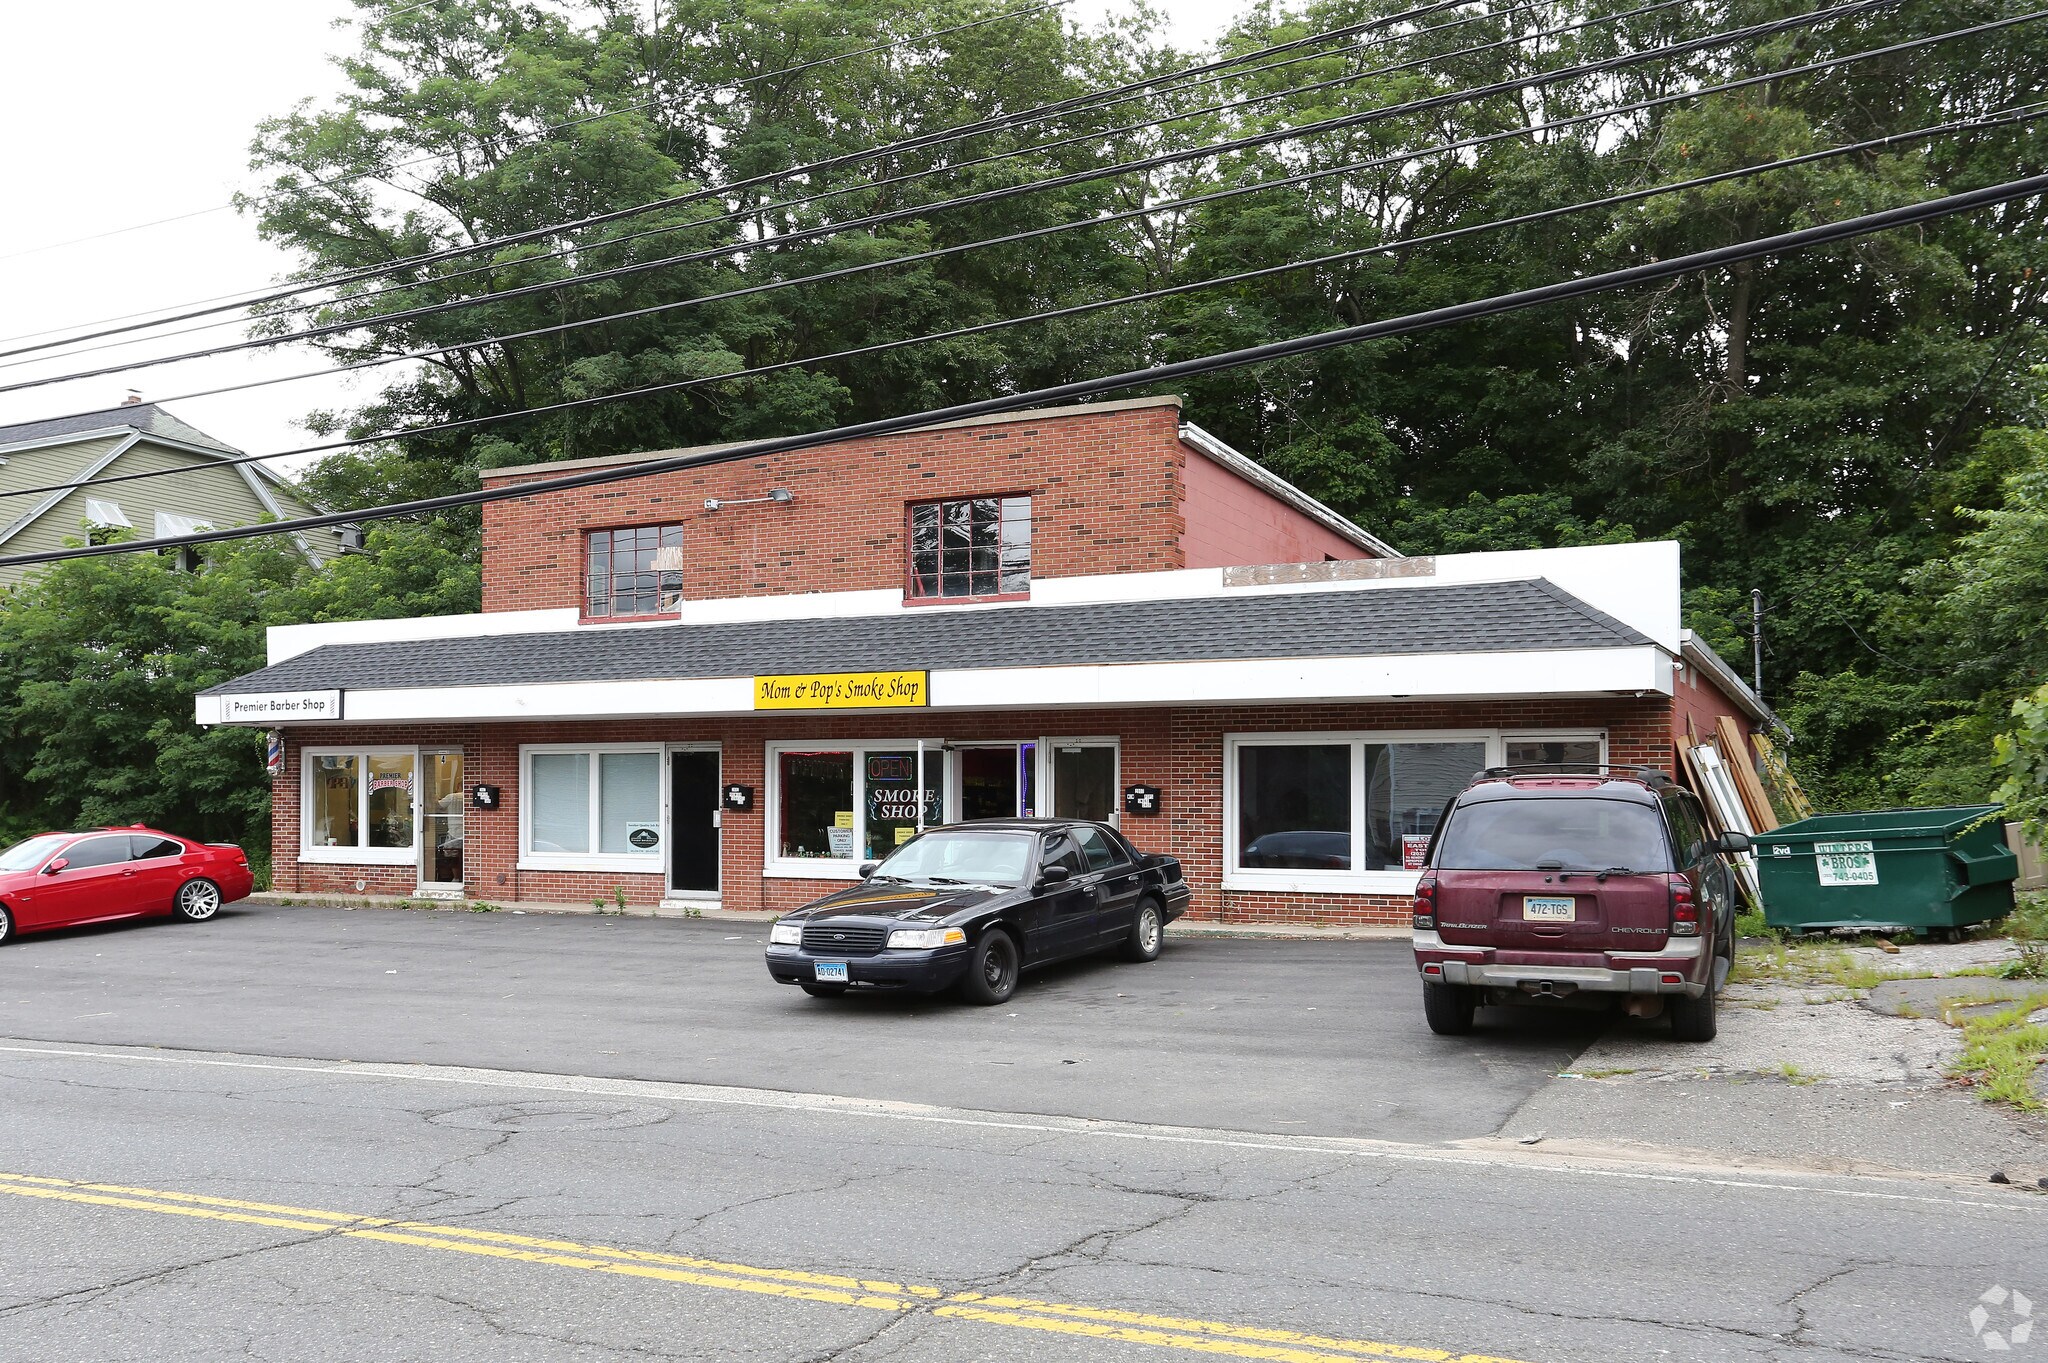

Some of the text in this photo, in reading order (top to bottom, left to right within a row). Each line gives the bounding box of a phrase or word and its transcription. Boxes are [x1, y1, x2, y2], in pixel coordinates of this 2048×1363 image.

[761, 676, 919, 704] Mom & Pop's Smoke Shop
[234, 699, 325, 712] Premier Barber Shop
[871, 760, 909, 777] OPEN
[1818, 843, 1870, 857] WINTERS
[1832, 856, 1861, 869] BROS
[1832, 872, 1874, 882] 743-0405
[1611, 926, 1668, 934] CHEVROLET
